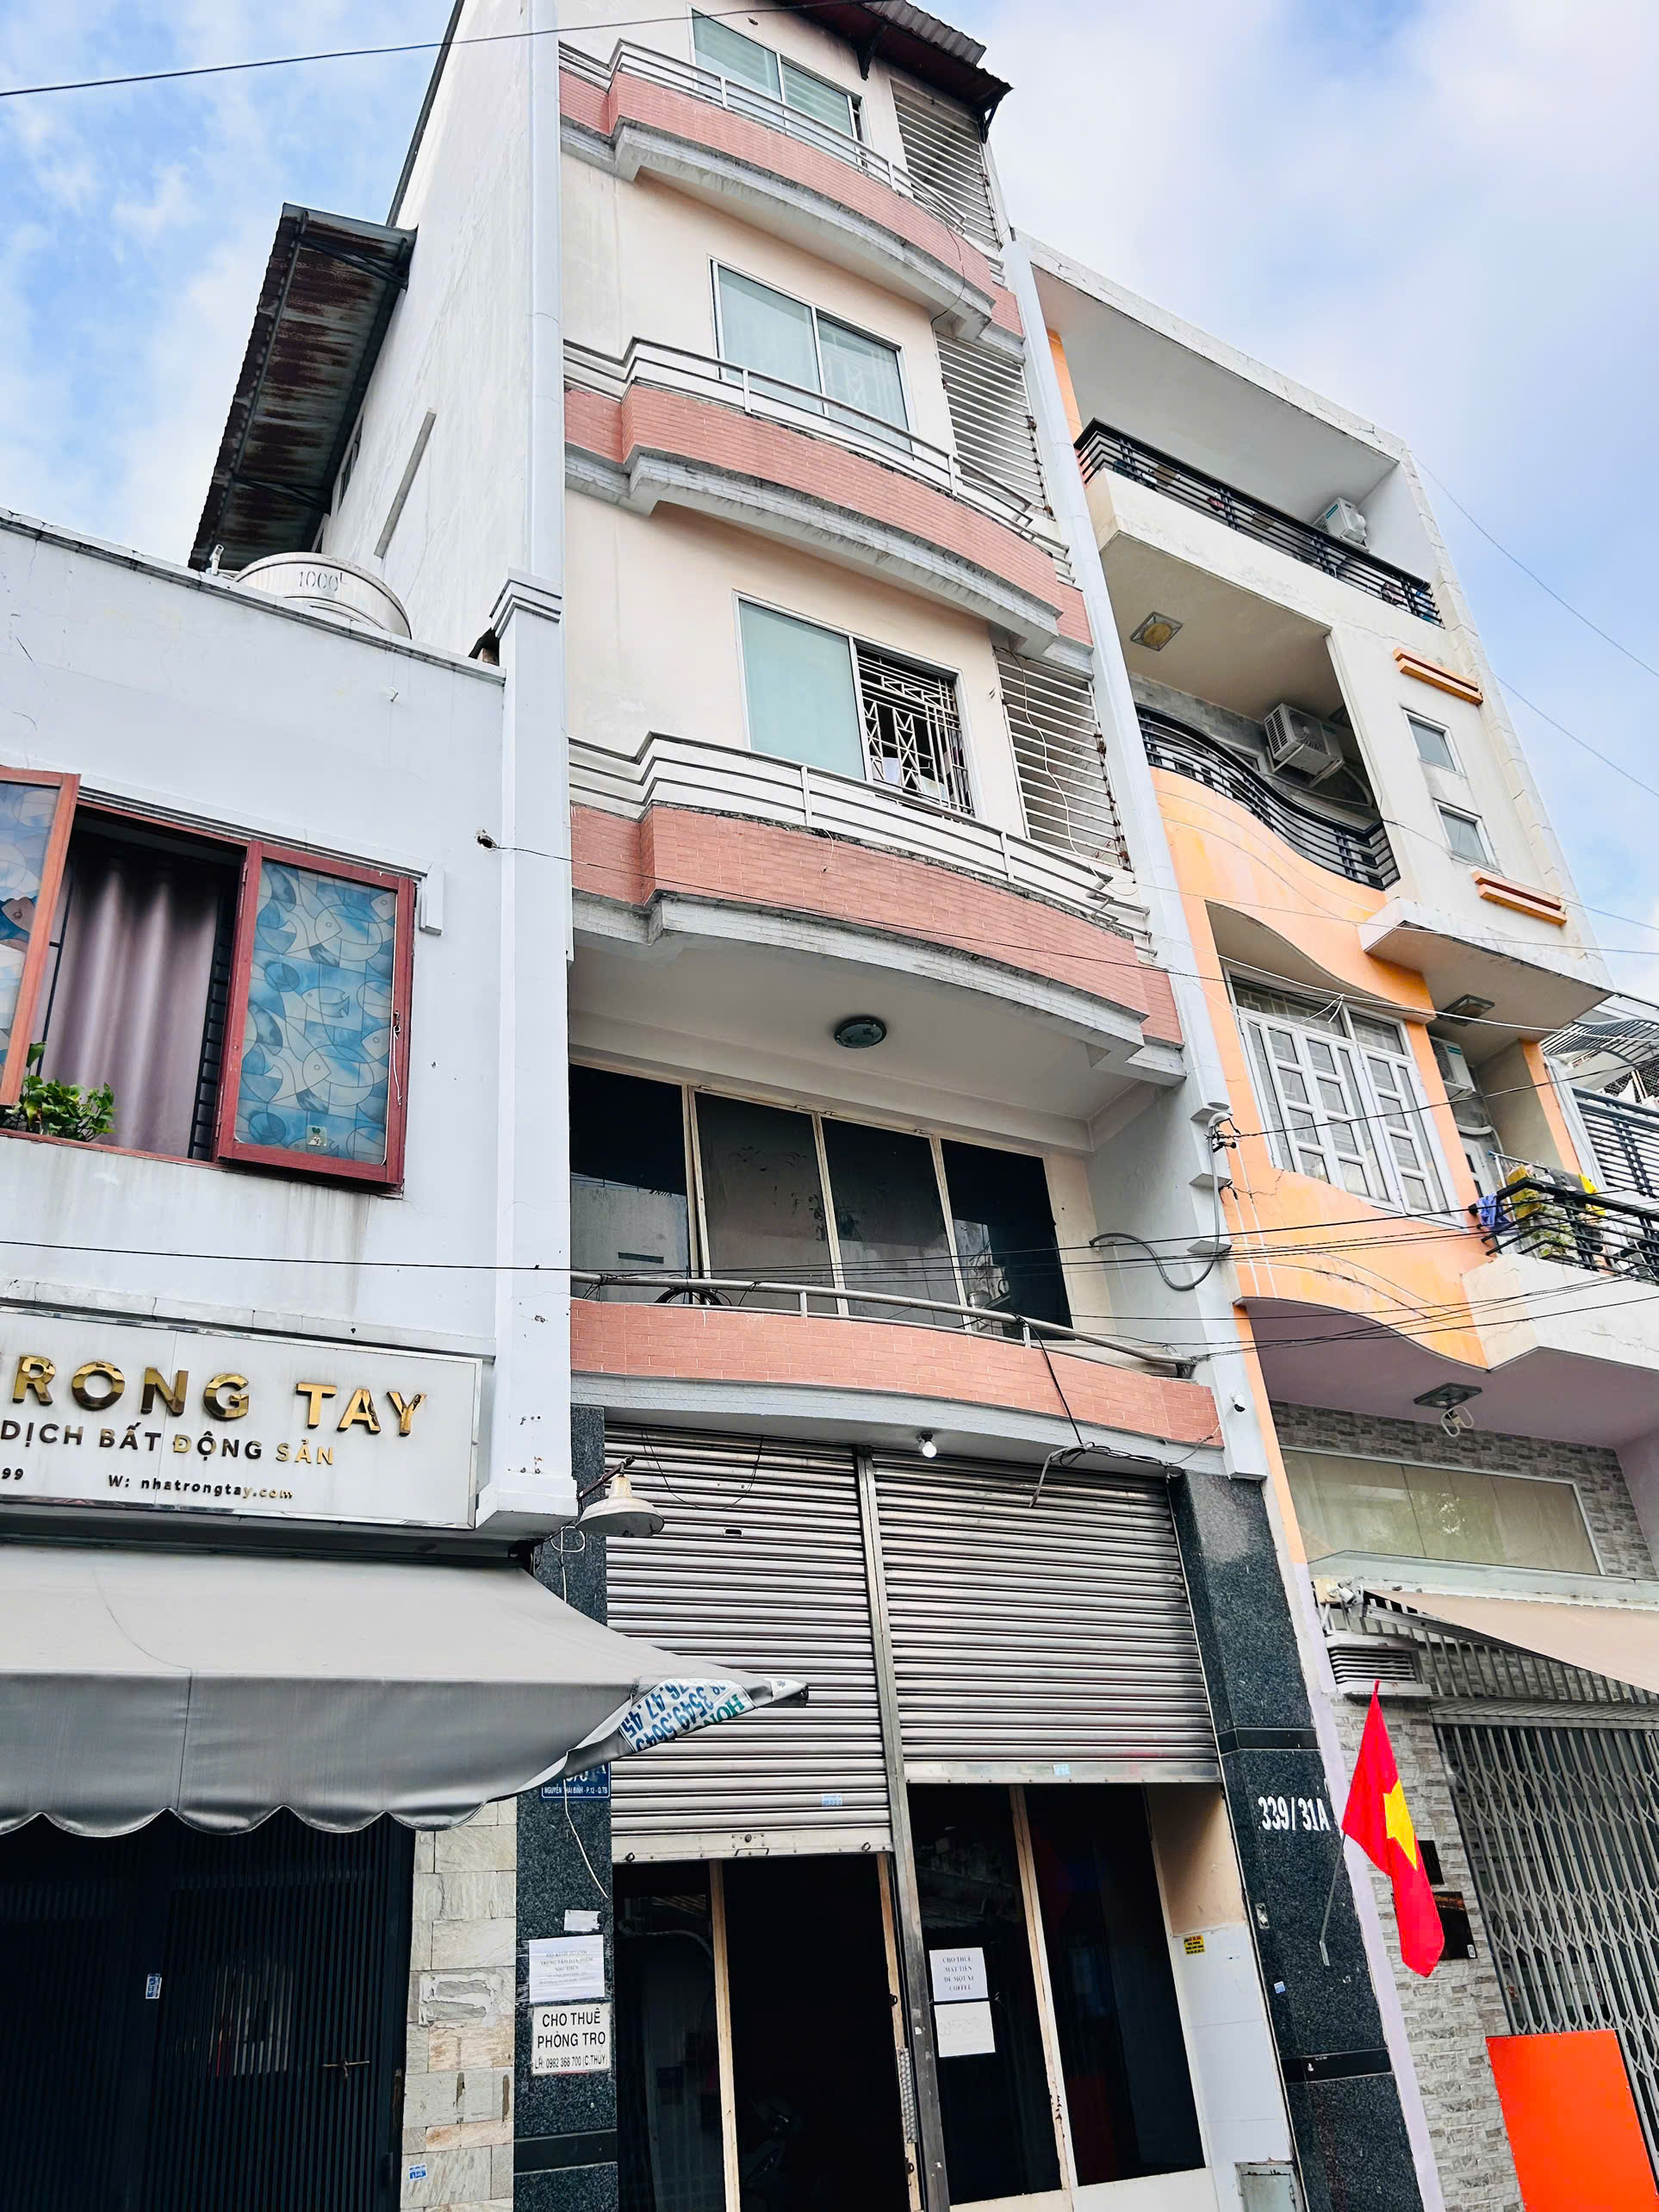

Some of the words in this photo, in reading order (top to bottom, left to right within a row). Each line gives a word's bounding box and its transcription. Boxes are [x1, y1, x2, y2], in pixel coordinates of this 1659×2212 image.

[296, 1382, 428, 1437] TAY
[0, 1420, 84, 1448] DỊCH
[99, 1421, 161, 1451] BẤT
[172, 1430, 262, 1462] ĐỘNG
[276, 1438, 334, 1465] SẢN
[109, 1474, 130, 1488] W:
[140, 1477, 294, 1500] nhatrongtay.com
[542, 2012, 568, 2028] CHO
[570, 2007, 600, 2026] THUÊ
[537, 2030, 579, 2048] PHÒNG
[582, 2031, 606, 2047] TRỌ
